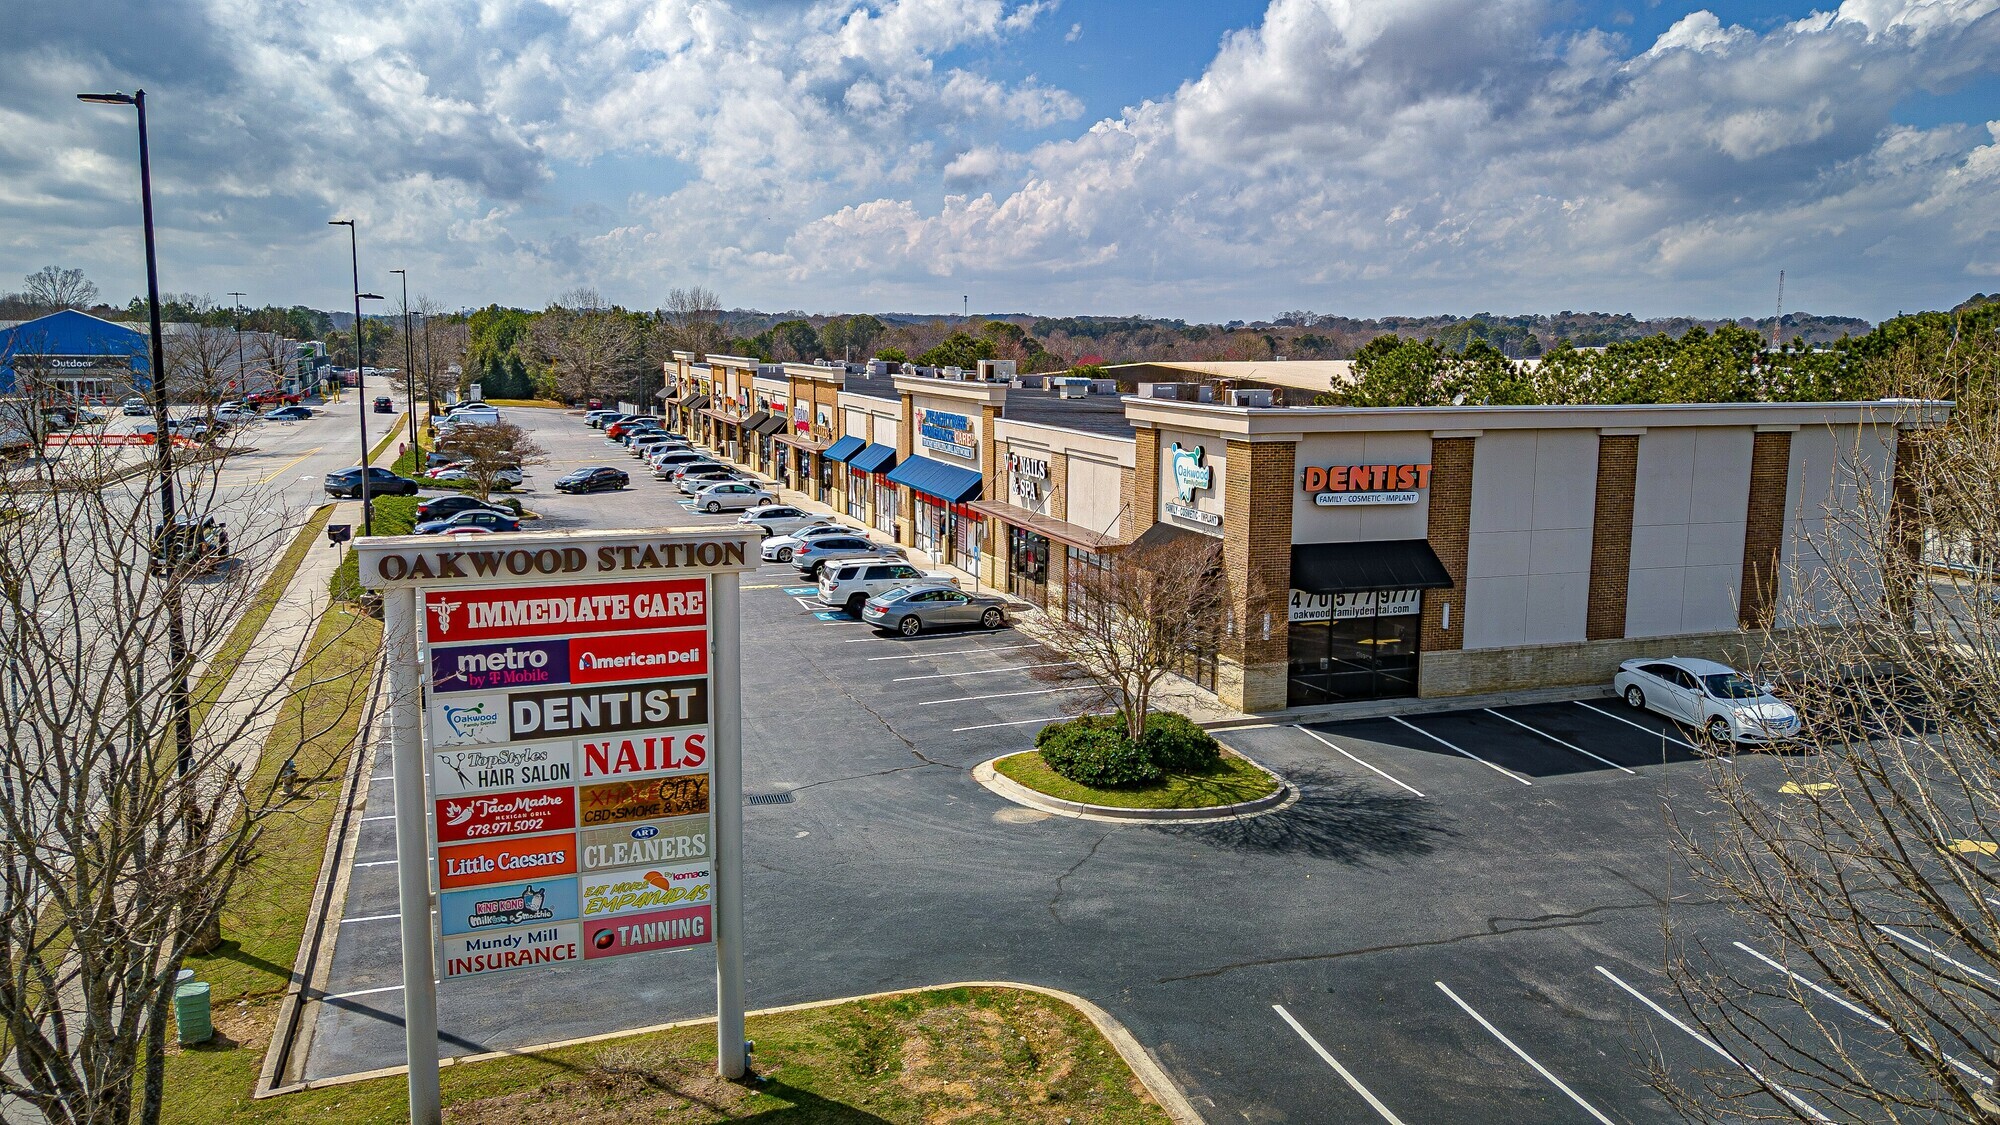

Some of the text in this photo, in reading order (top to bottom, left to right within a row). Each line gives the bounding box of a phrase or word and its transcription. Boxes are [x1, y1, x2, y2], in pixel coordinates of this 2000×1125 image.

[52, 359, 93, 368] Outdoor
[1020, 456, 1047, 480] NAILS
[1178, 464, 1209, 481] Oakwood
[1304, 464, 1433, 492] DENTIST
[1020, 479, 1036, 500] SPA
[1319, 495, 1343, 503] FAMILY
[1348, 494, 1381, 503] COSMETIC
[1386, 494, 1416, 502] IMPLANT
[378, 541, 747, 581] OAKWOOD STATION
[467, 591, 704, 629] IMMEDIATE CARE
[456, 647, 548, 682] metro
[579, 648, 700, 671] American Deli
[469, 673, 486, 688] by
[503, 668, 549, 684] Mobile
[453, 712, 498, 724] Oakwood
[512, 687, 697, 734] DENTIST
[583, 734, 706, 777] NAILS
[478, 762, 570, 788] HAIR SALON
[495, 812, 527, 821] MEXICAN
[663, 802, 673, 814] &
[675, 799, 706, 812] VAPE
[466, 818, 544, 837] 678.971.5092
[635, 827, 655, 837] ART
[446, 850, 566, 876] Little Caesars
[584, 834, 707, 869] CLEANERS
[584, 880, 650, 898] EAT MORE
[500, 898, 524, 911] KONG
[466, 928, 558, 952] Mundy Mill
[617, 916, 704, 947] TANNING
[448, 943, 578, 976] INSURANCE
